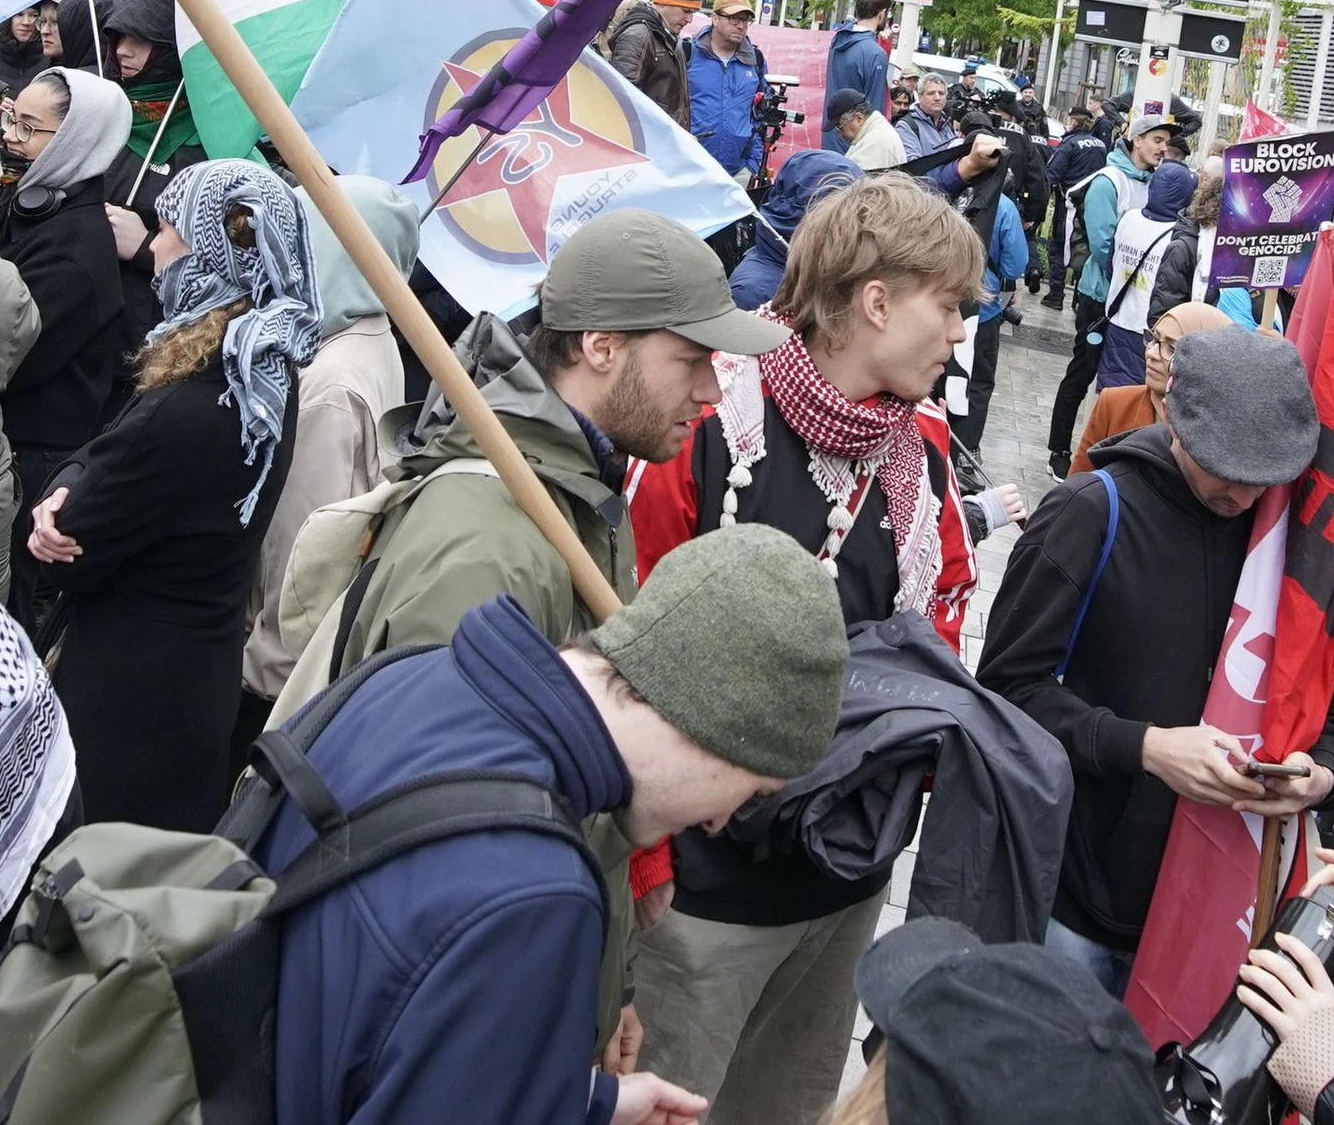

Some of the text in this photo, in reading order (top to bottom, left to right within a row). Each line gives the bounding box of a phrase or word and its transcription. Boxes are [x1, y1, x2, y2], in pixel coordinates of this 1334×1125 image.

[1256, 141, 1318, 159] BLOCK
[1216, 231, 1319, 246] DON'T CELEBRAT
[1238, 243, 1303, 257] GENOCIDE
